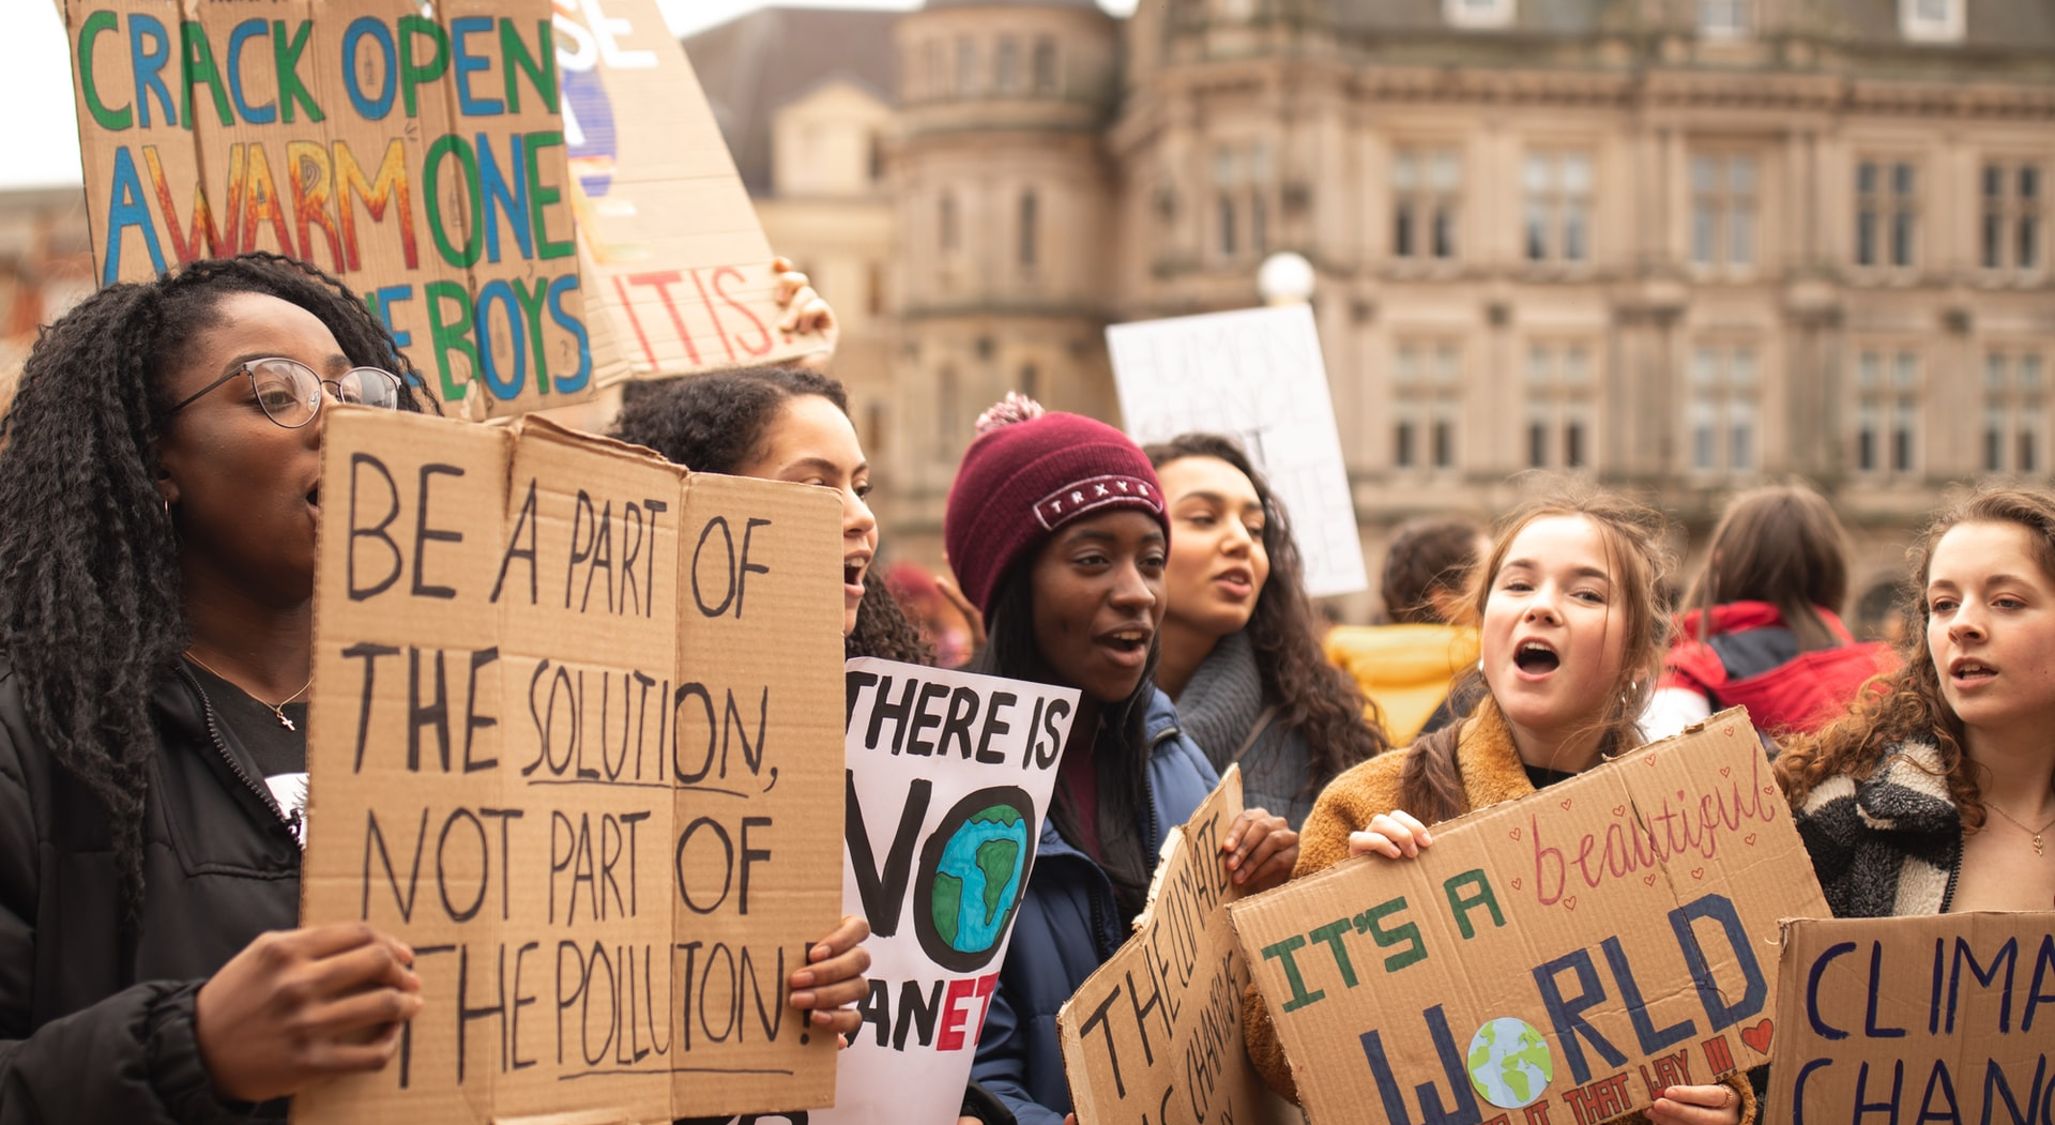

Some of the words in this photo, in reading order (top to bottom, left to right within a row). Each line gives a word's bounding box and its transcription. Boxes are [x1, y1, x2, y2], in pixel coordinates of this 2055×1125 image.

[78, 9, 322, 131] CRACK
[342, 15, 559, 121] OPEN
[103, 145, 169, 288] A
[142, 138, 419, 274] WARM
[424, 130, 577, 268] ONE
[424, 274, 592, 402] BOYS
[347, 452, 465, 601] BE
[489, 478, 538, 605] A
[566, 489, 668, 618] PART
[691, 516, 772, 619] OF
[341, 642, 499, 774] THE
[521, 659, 778, 793] SOLUTION,
[846, 671, 1017, 764] THERE
[1022, 697, 1070, 770] IS
[363, 807, 523, 924] NOT
[548, 810, 651, 926] PART
[676, 816, 772, 915] OF
[1260, 896, 1428, 1012] IT'S
[1443, 868, 1507, 940] A
[1531, 744, 1775, 905] beautiful
[1080, 919, 1181, 1099] THE
[1166, 811, 1228, 988] CLIMATE
[1561, 1072, 1632, 1125] THAT
[1638, 1048, 1693, 1101] WAY
[1793, 1053, 2055, 1125] CHAN
